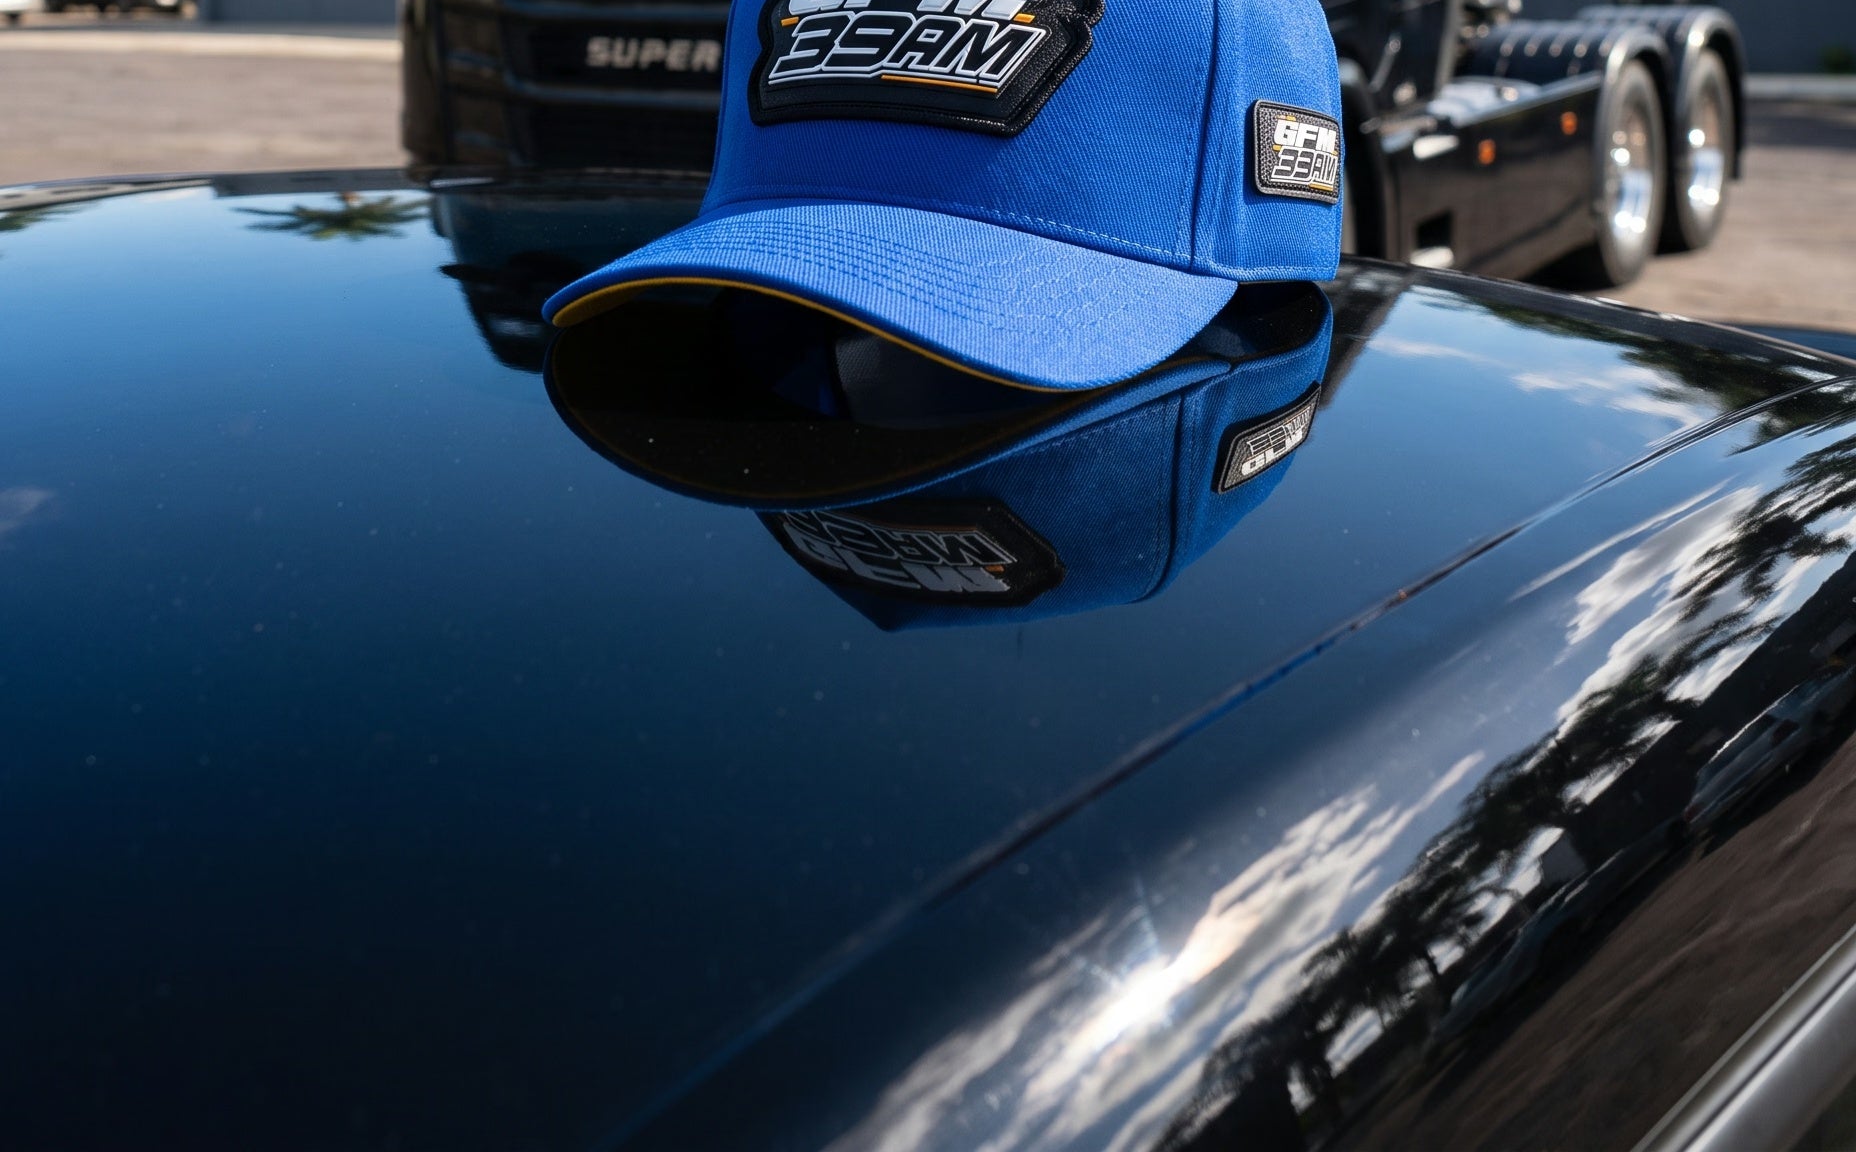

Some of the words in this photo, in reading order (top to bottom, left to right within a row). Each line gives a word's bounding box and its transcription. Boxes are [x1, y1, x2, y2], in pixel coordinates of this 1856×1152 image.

[585, 35, 723, 73] SUPER
[768, 10, 1047, 81] 39AM
[1273, 119, 1337, 154] GFM
